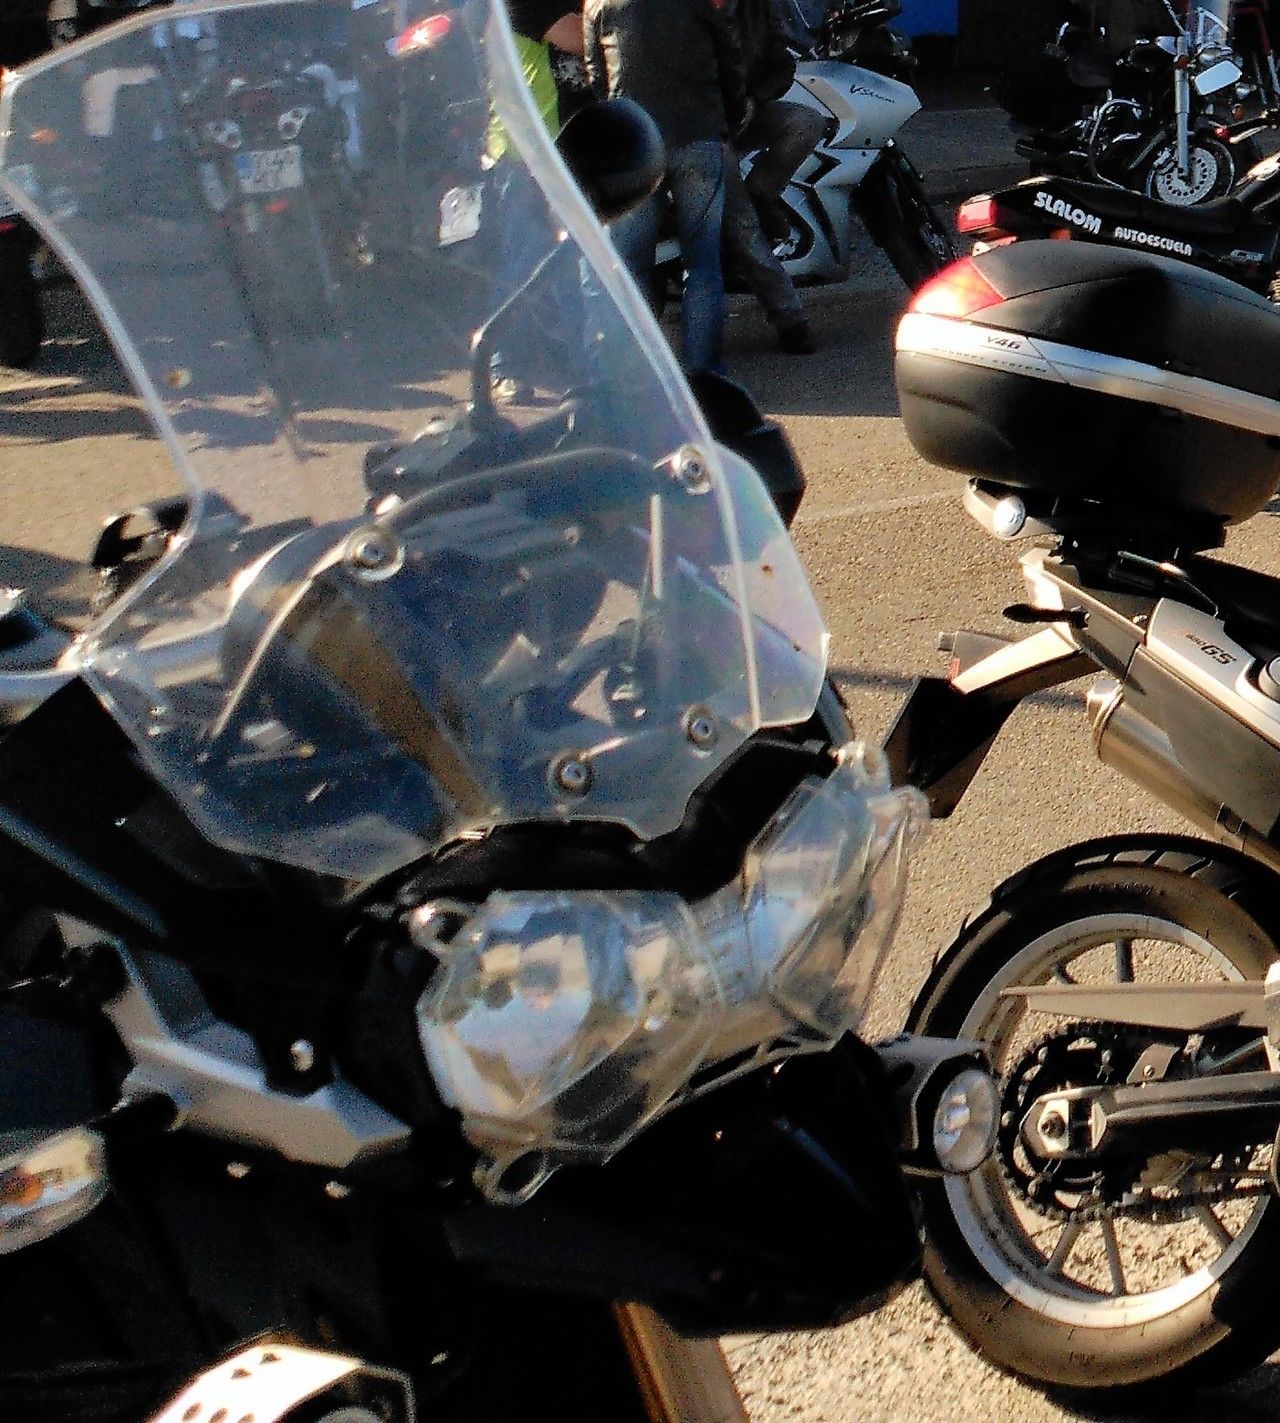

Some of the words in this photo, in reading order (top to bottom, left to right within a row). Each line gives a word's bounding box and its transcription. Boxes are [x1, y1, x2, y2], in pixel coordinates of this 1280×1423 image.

[1033, 191, 1102, 235] SLALOM
[1114, 226, 1193, 257] AUTOESCUELA
[987, 335, 1022, 350] V46
[1200, 644, 1237, 665] GS
